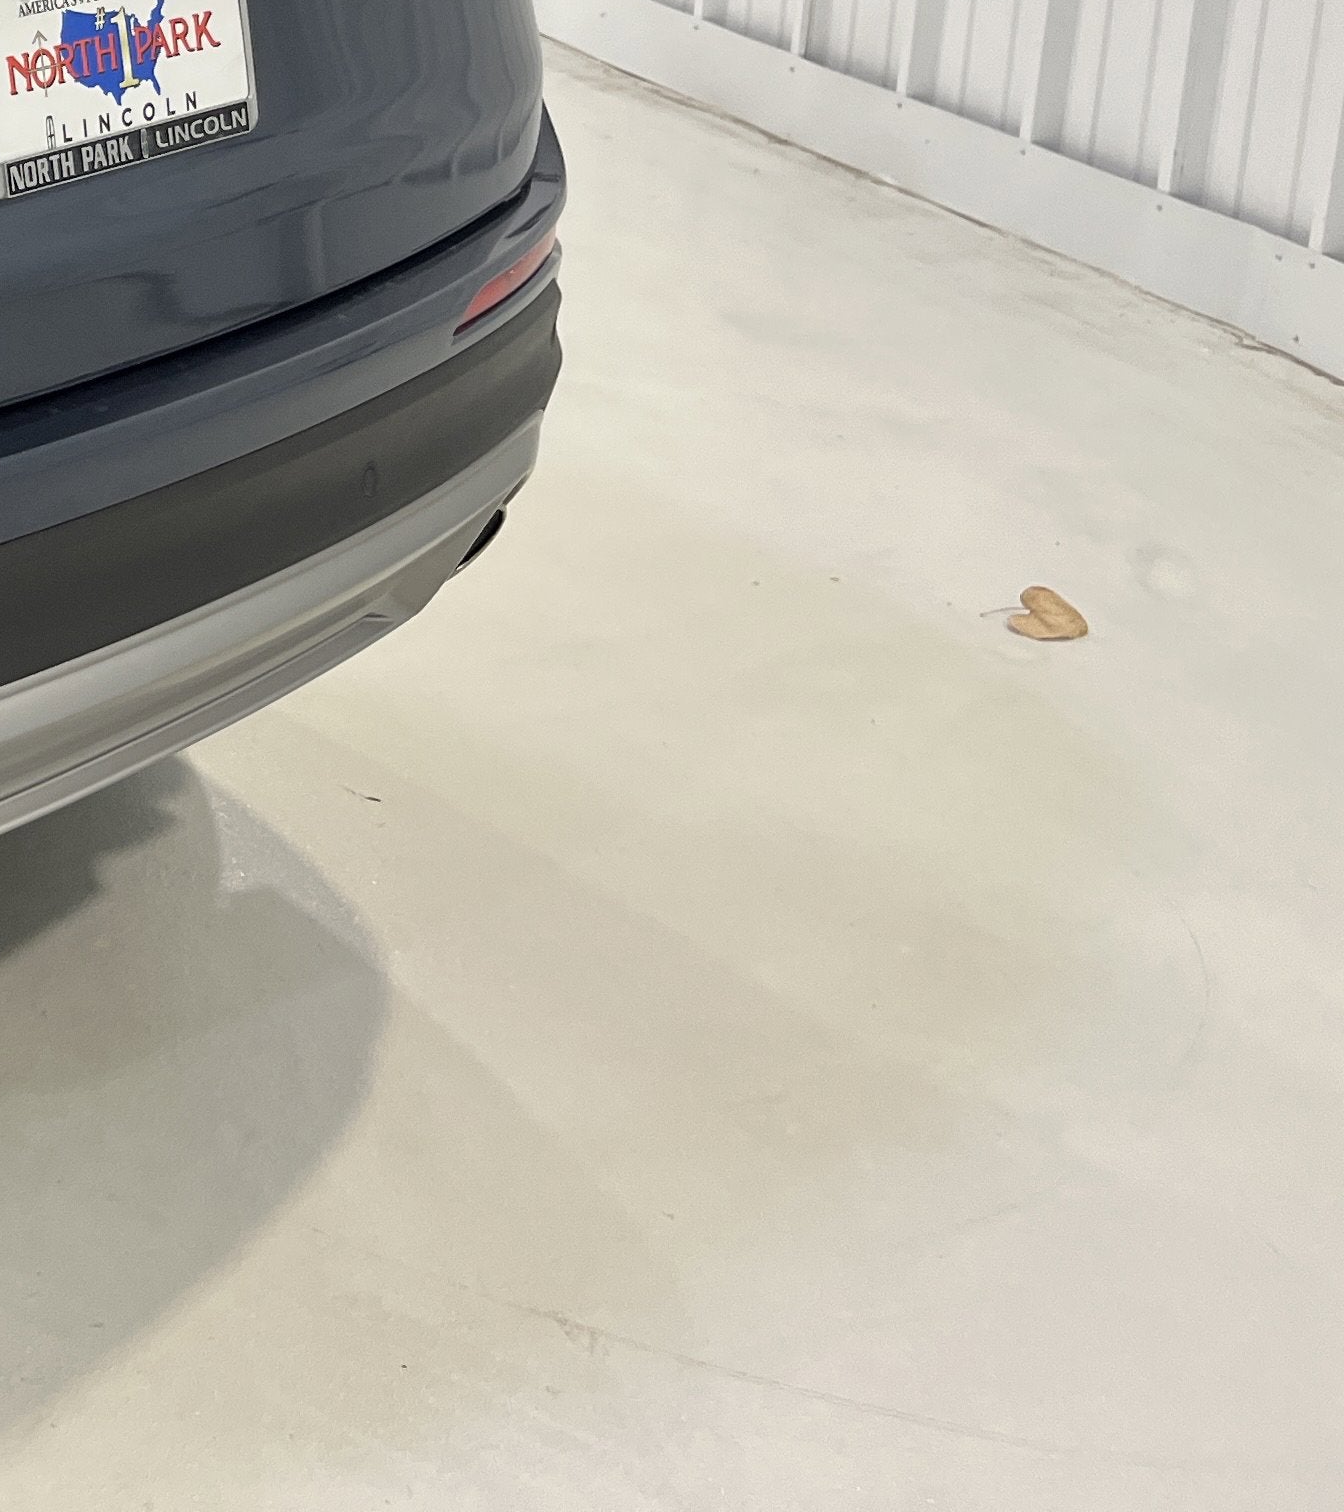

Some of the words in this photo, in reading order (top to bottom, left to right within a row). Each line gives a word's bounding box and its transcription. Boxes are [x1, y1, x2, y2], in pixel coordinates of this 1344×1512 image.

[6, 31, 119, 96] NORTH
[133, 9, 222, 65] PARK
[9, 148, 76, 193] NORTH
[81, 136, 135, 173] PARK
[155, 105, 249, 150] LINCOLN
[62, 90, 198, 145] LINCOLN
